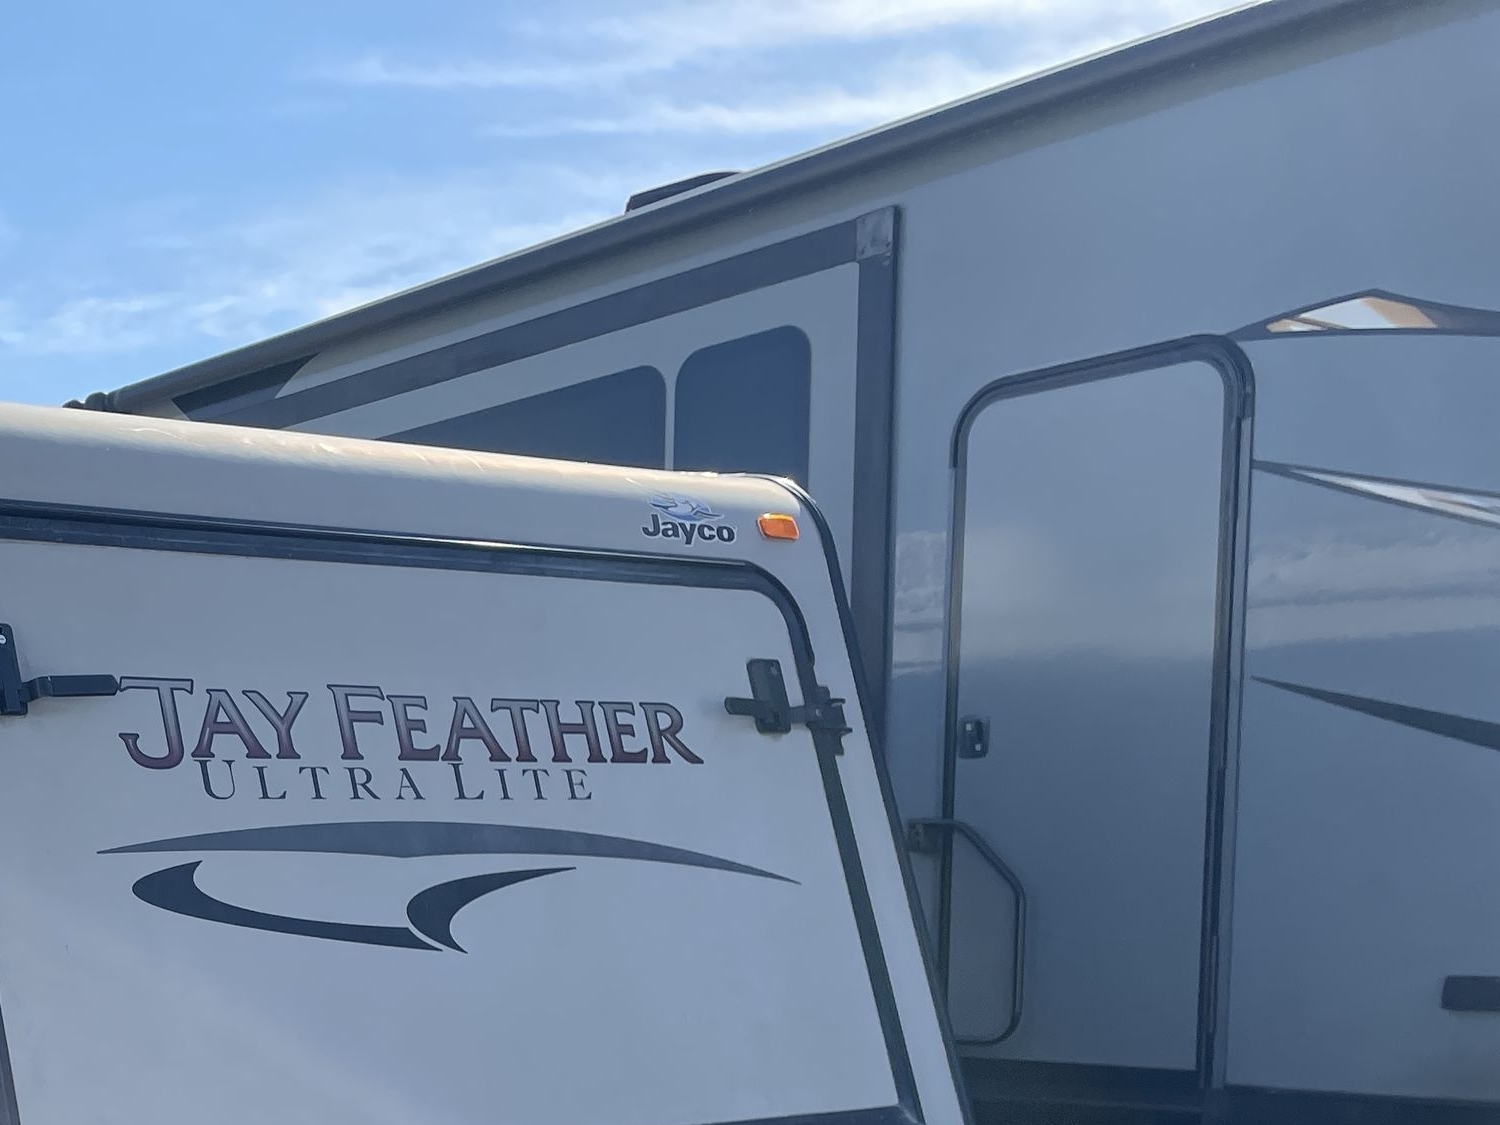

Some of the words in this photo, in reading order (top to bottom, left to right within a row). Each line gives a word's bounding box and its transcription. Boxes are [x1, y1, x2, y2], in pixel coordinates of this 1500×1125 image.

[641, 513, 736, 545] Jayco
[118, 676, 309, 770] JAY
[326, 683, 705, 766] FEATHER
[194, 759, 427, 801] ULTRA
[449, 762, 594, 801] LITE
